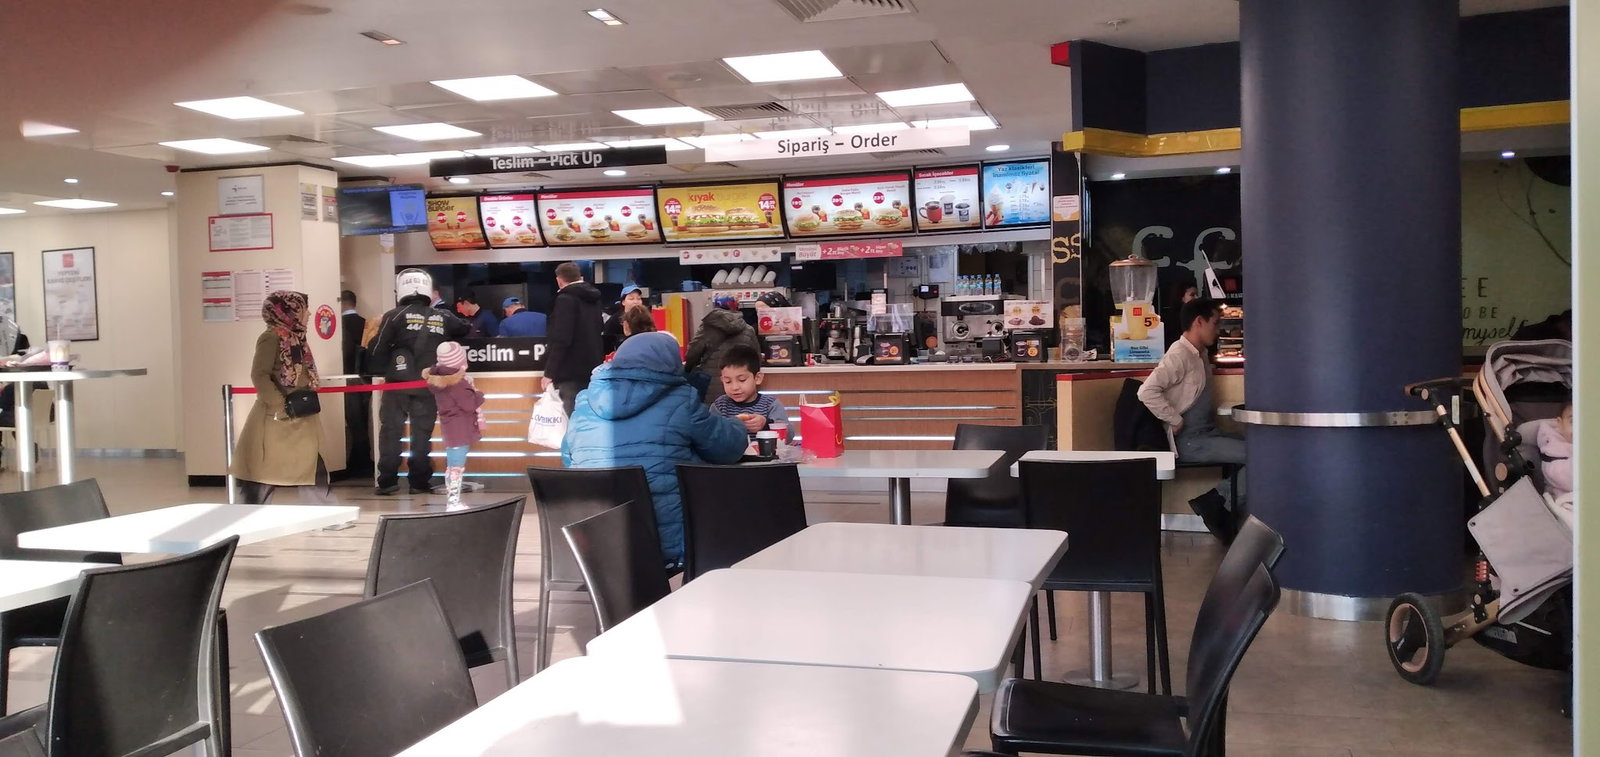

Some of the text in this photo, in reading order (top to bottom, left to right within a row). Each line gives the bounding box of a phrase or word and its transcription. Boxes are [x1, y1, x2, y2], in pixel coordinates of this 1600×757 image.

[777, 136, 830, 157] Sipariş
[850, 132, 898, 149] Order
[489, 156, 535, 170] Teslim
[550, 152, 579, 167] Pick
[581, 150, 603, 167] Up
[1144, 316, 1152, 327] 5
[1479, 306, 1498, 319] BE
[533, 343, 548, 361] P
